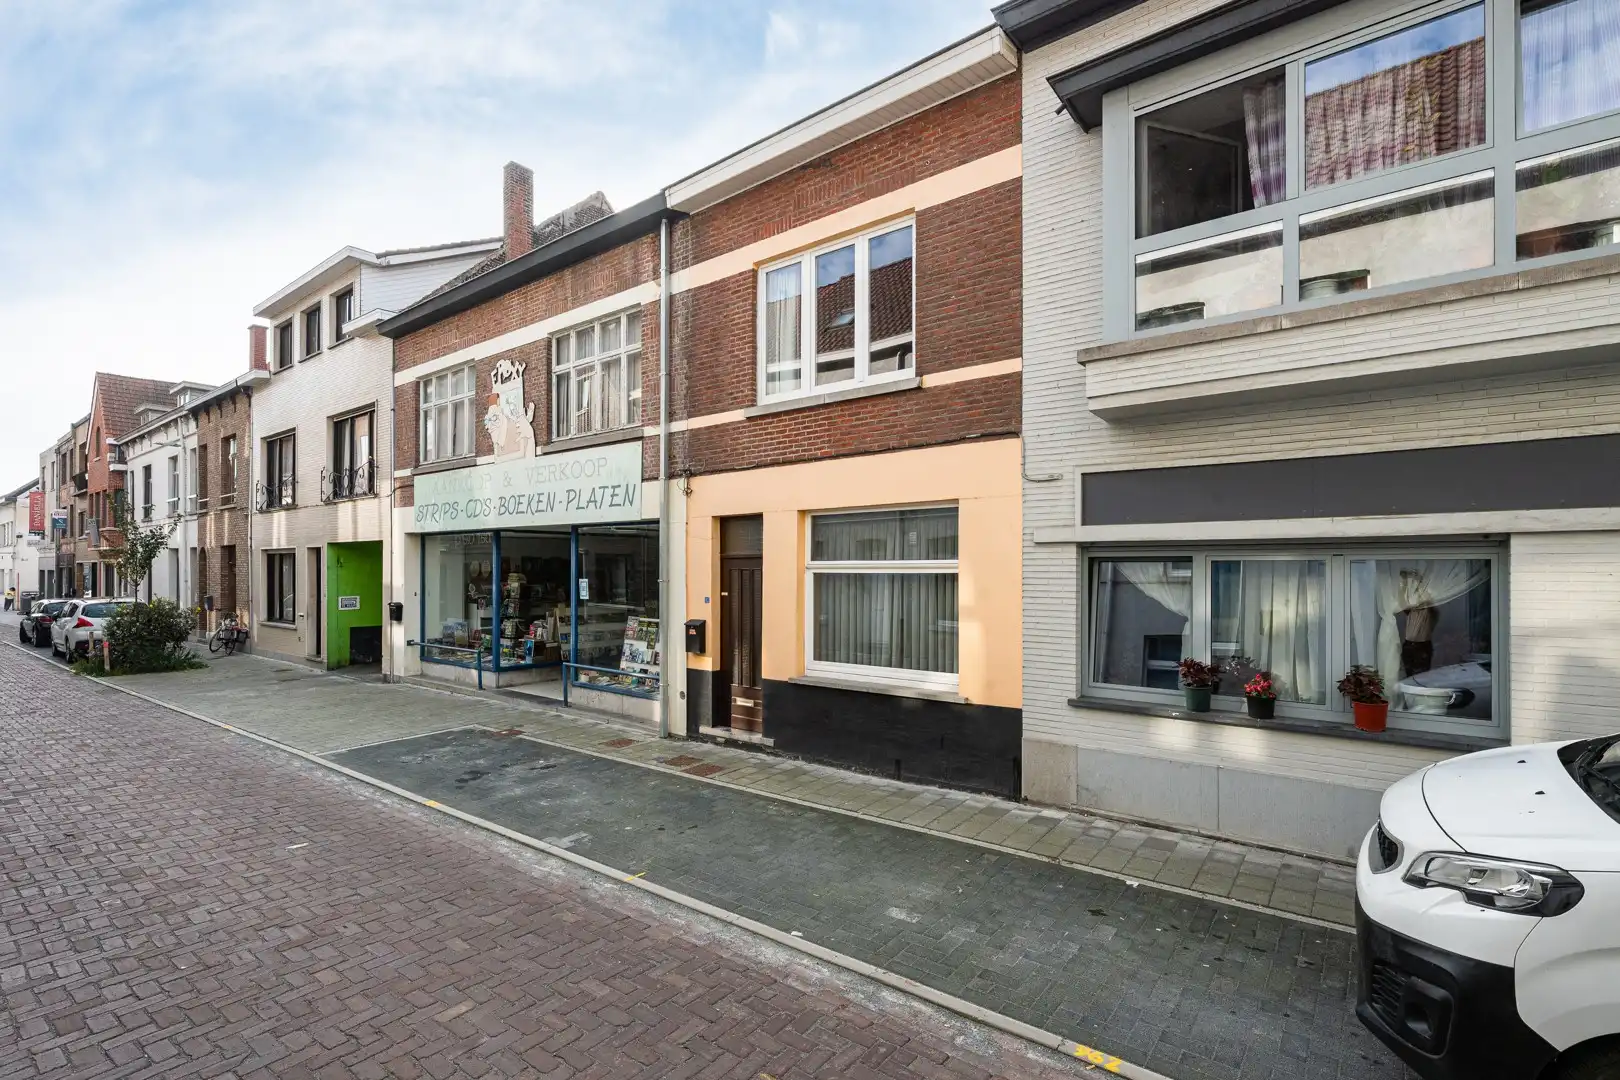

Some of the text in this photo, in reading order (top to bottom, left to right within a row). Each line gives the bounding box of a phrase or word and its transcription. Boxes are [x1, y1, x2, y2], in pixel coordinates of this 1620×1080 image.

[524, 457, 608, 484] VERKOOP
[498, 491, 556, 516] BOEKEN
[565, 483, 637, 511] PLATEN
